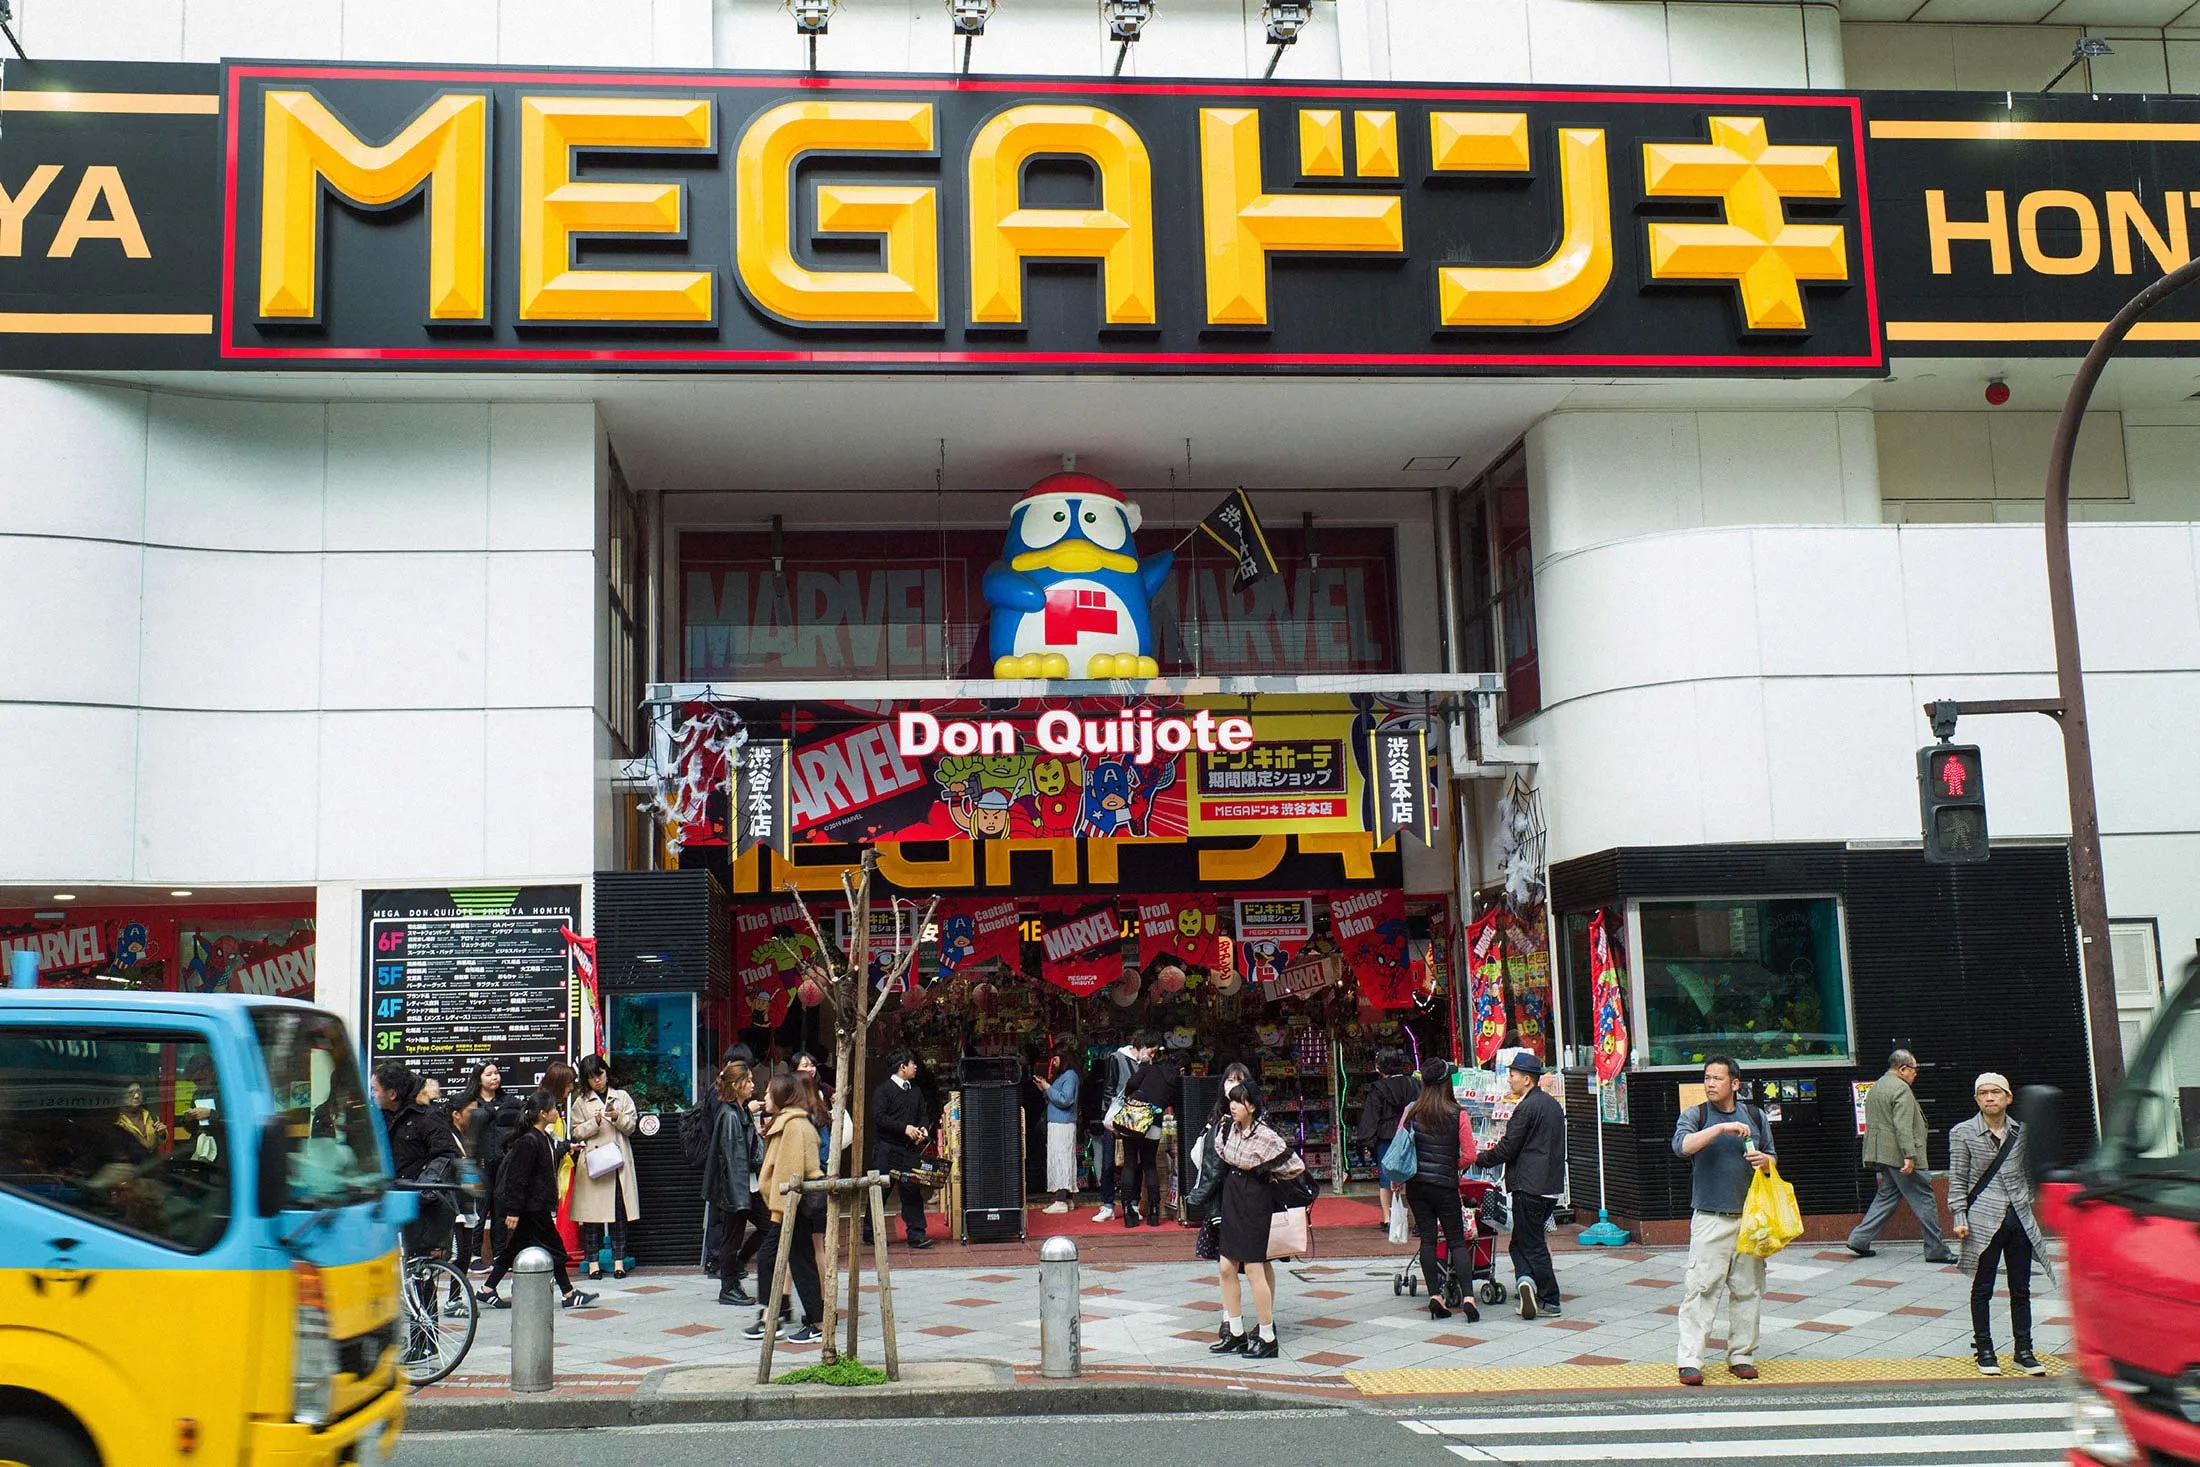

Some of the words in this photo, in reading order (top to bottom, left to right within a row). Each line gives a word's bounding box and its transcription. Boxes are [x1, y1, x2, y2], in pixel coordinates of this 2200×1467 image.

[1925, 189, 2200, 275] HON
[898, 711, 1014, 756] Don
[1037, 708, 1254, 764] Quijote
[1208, 770, 1332, 788] 期間限定ショップ
[1387, 737, 1413, 824] 渋谷本店
[749, 746, 771, 837] 渋谷本店
[1281, 802, 1332, 815] 渋谷本店
[373, 909, 400, 918] MEGA
[482, 907, 524, 915] SHIBUYA
[532, 906, 571, 915] HONTEN
[974, 902, 1014, 922] Captain
[1139, 902, 1171, 921] Iron
[1331, 889, 1389, 919] Spider-
[736, 913, 769, 933] The
[978, 912, 1020, 935] America
[1144, 918, 1176, 938] Man
[1338, 915, 1375, 940] Man
[378, 931, 405, 952] 6F
[1042, 911, 1119, 960] MARVEL
[378, 966, 404, 986] 5F
[739, 962, 772, 986] Thor
[377, 998, 403, 1018] 4F
[376, 1031, 402, 1051] 3F
